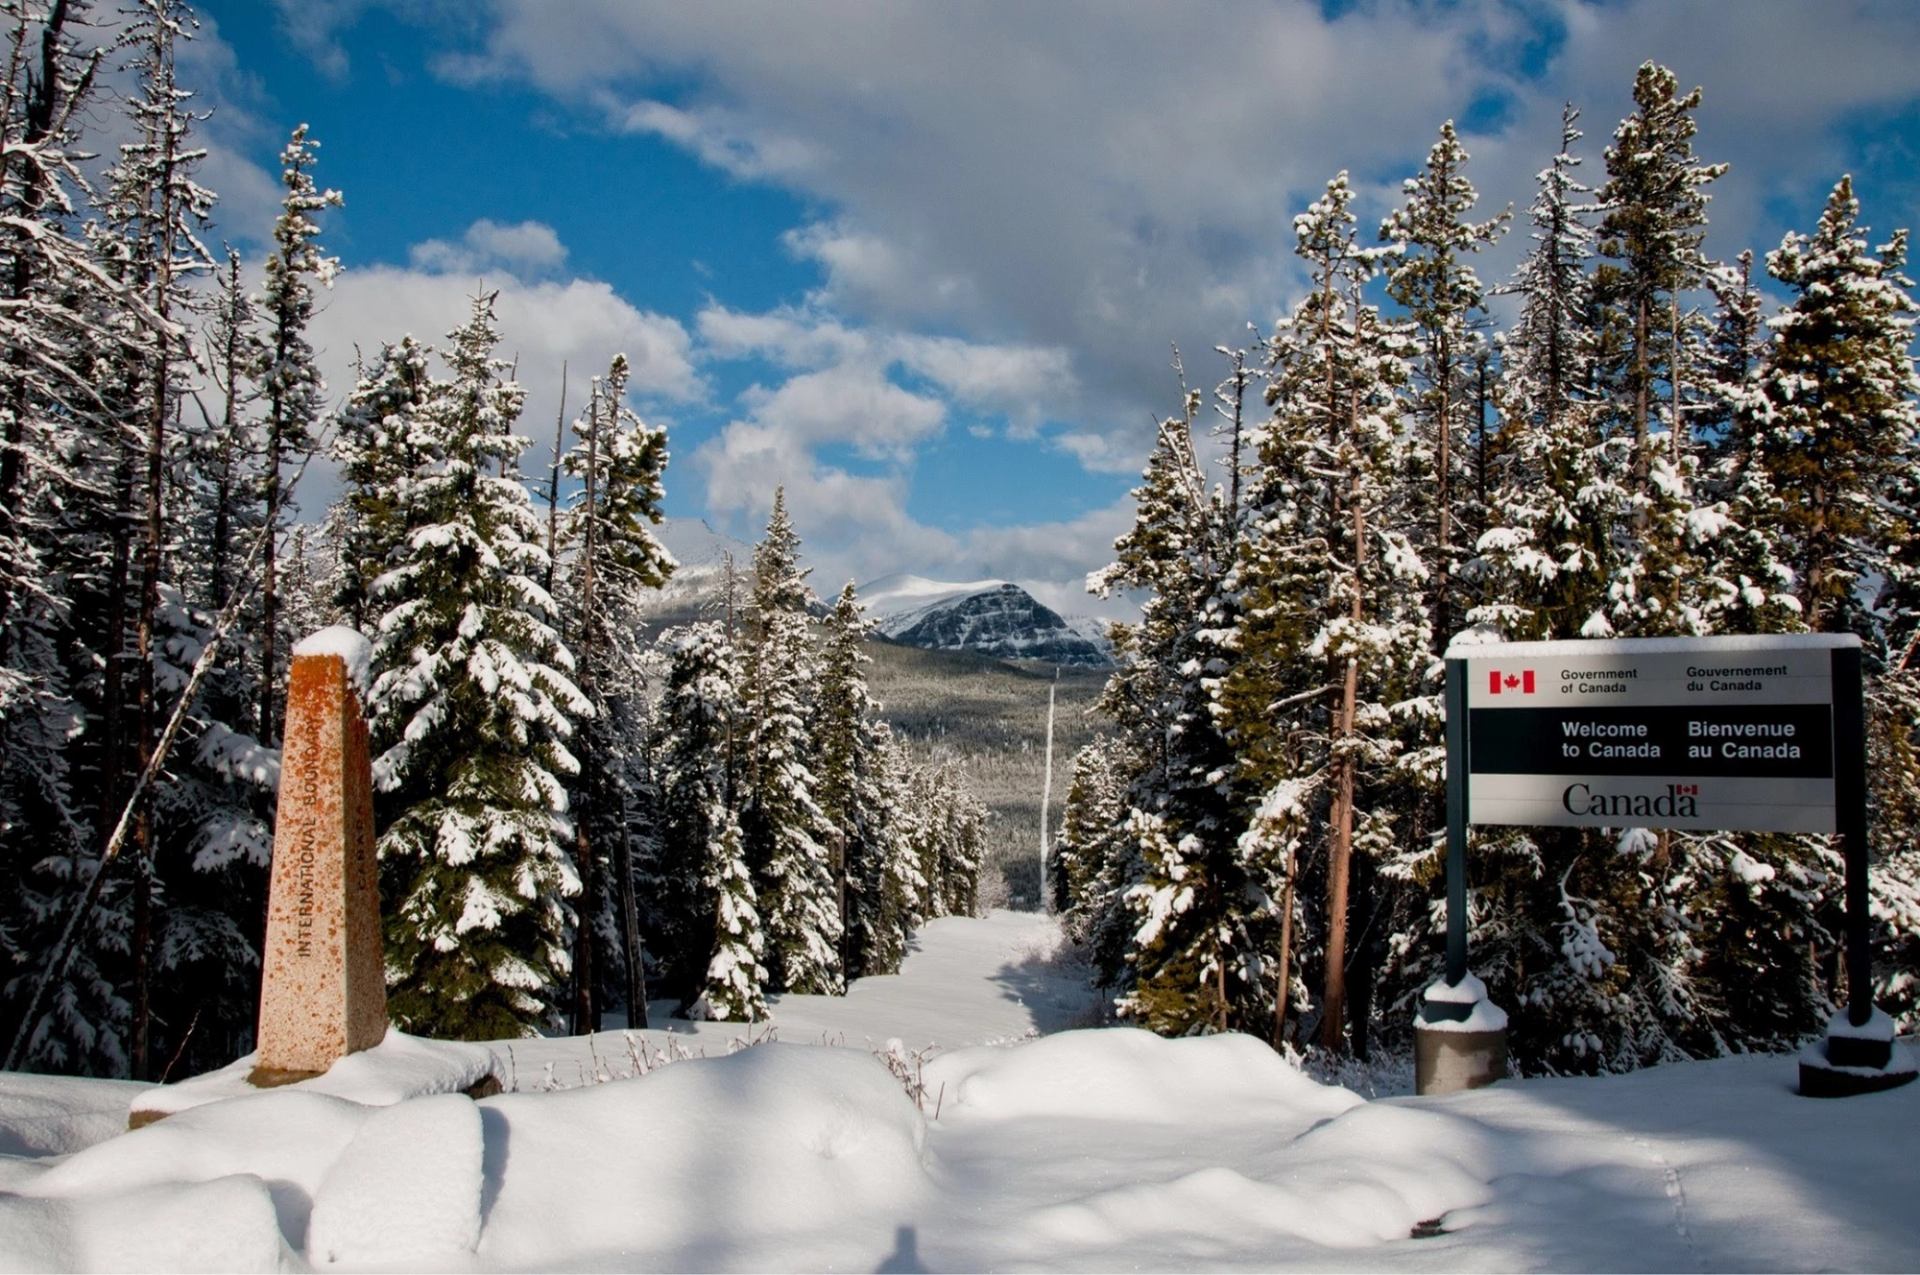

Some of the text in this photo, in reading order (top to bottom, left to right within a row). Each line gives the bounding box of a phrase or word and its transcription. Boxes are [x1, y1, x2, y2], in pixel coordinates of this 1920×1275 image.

[1560, 668, 1638, 681] Government
[1686, 664, 1788, 678] Gouvernement
[1561, 681, 1627, 694] of Canada
[1687, 679, 1763, 692] du Canada
[1561, 721, 1648, 738] Welcome
[1688, 721, 1796, 738] Bienvenue
[1561, 742, 1661, 758] to Canada
[1688, 742, 1801, 759] au Canada
[1562, 782, 1699, 818] Canada
[298, 817, 316, 957] INTERNATIONAL
